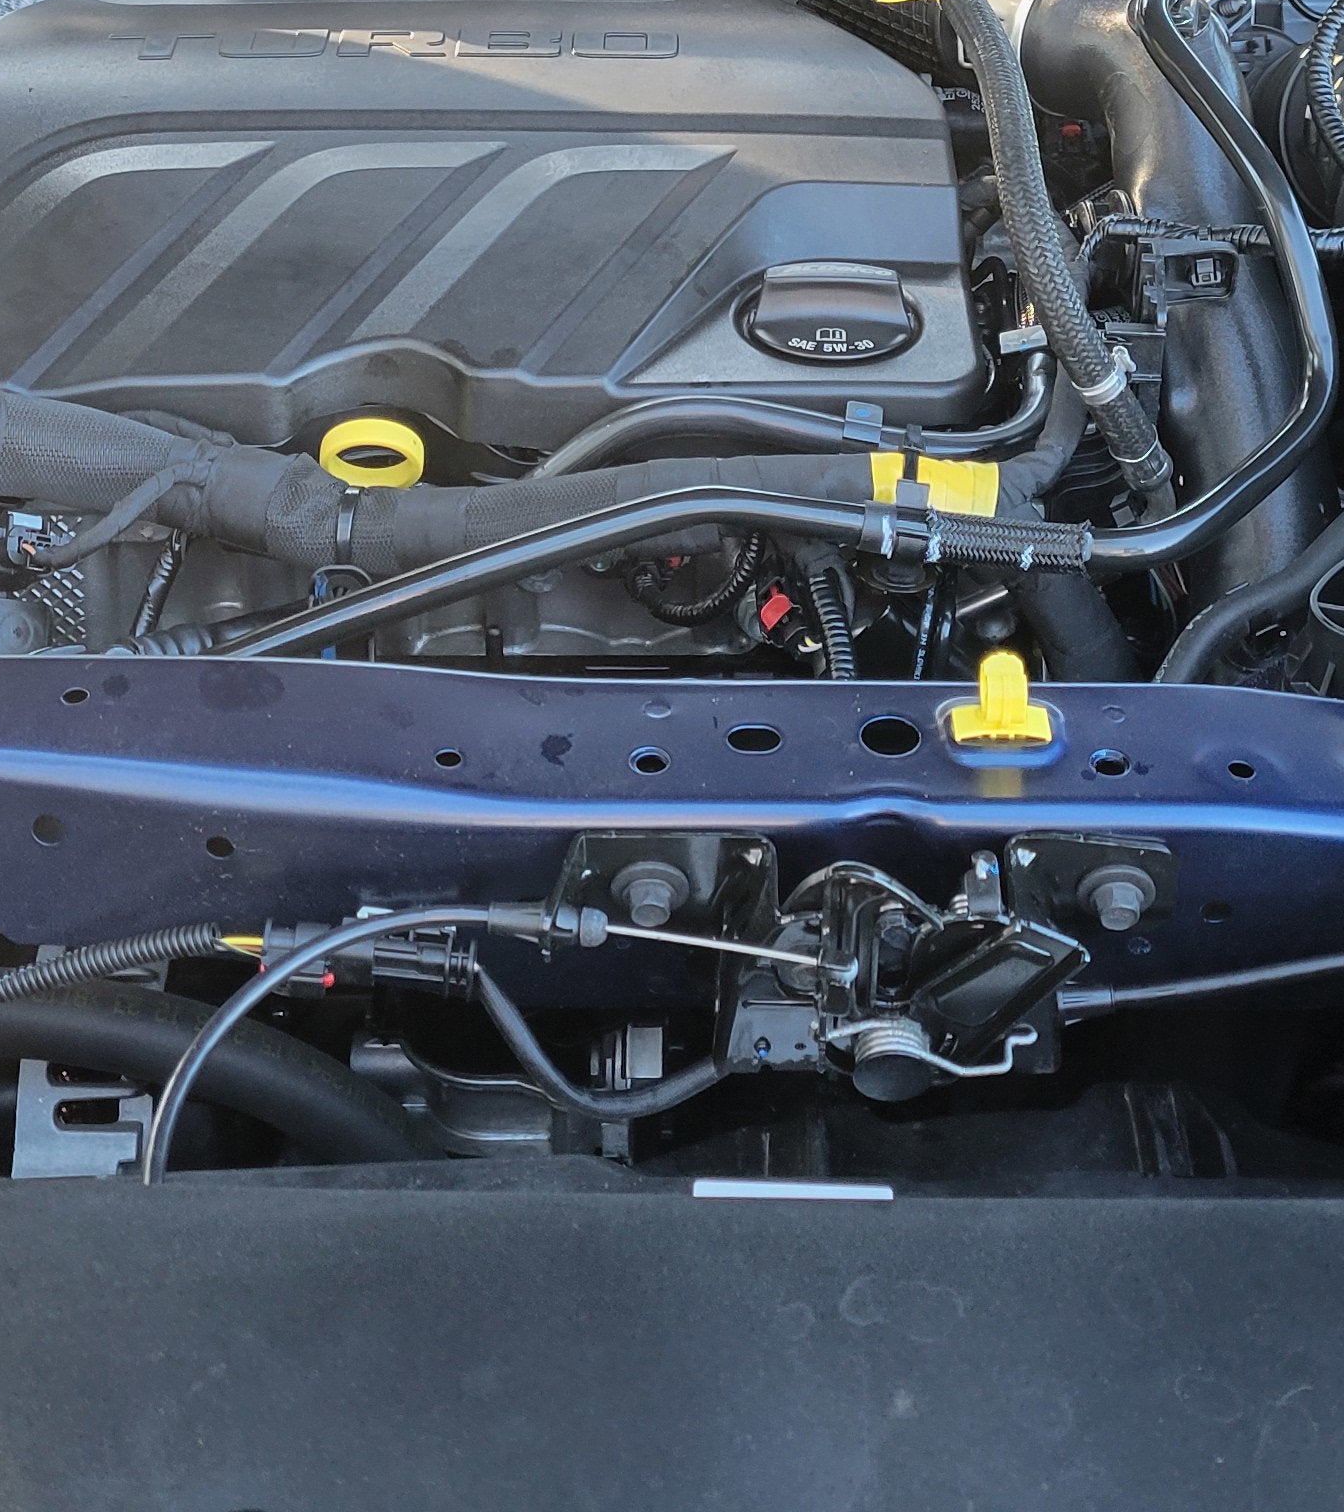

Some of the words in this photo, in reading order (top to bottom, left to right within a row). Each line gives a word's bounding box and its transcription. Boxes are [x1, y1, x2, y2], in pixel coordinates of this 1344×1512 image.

[109, 29, 679, 60] TURBO
[788, 337, 817, 351] SAE
[823, 339, 875, 353] 5W-30
